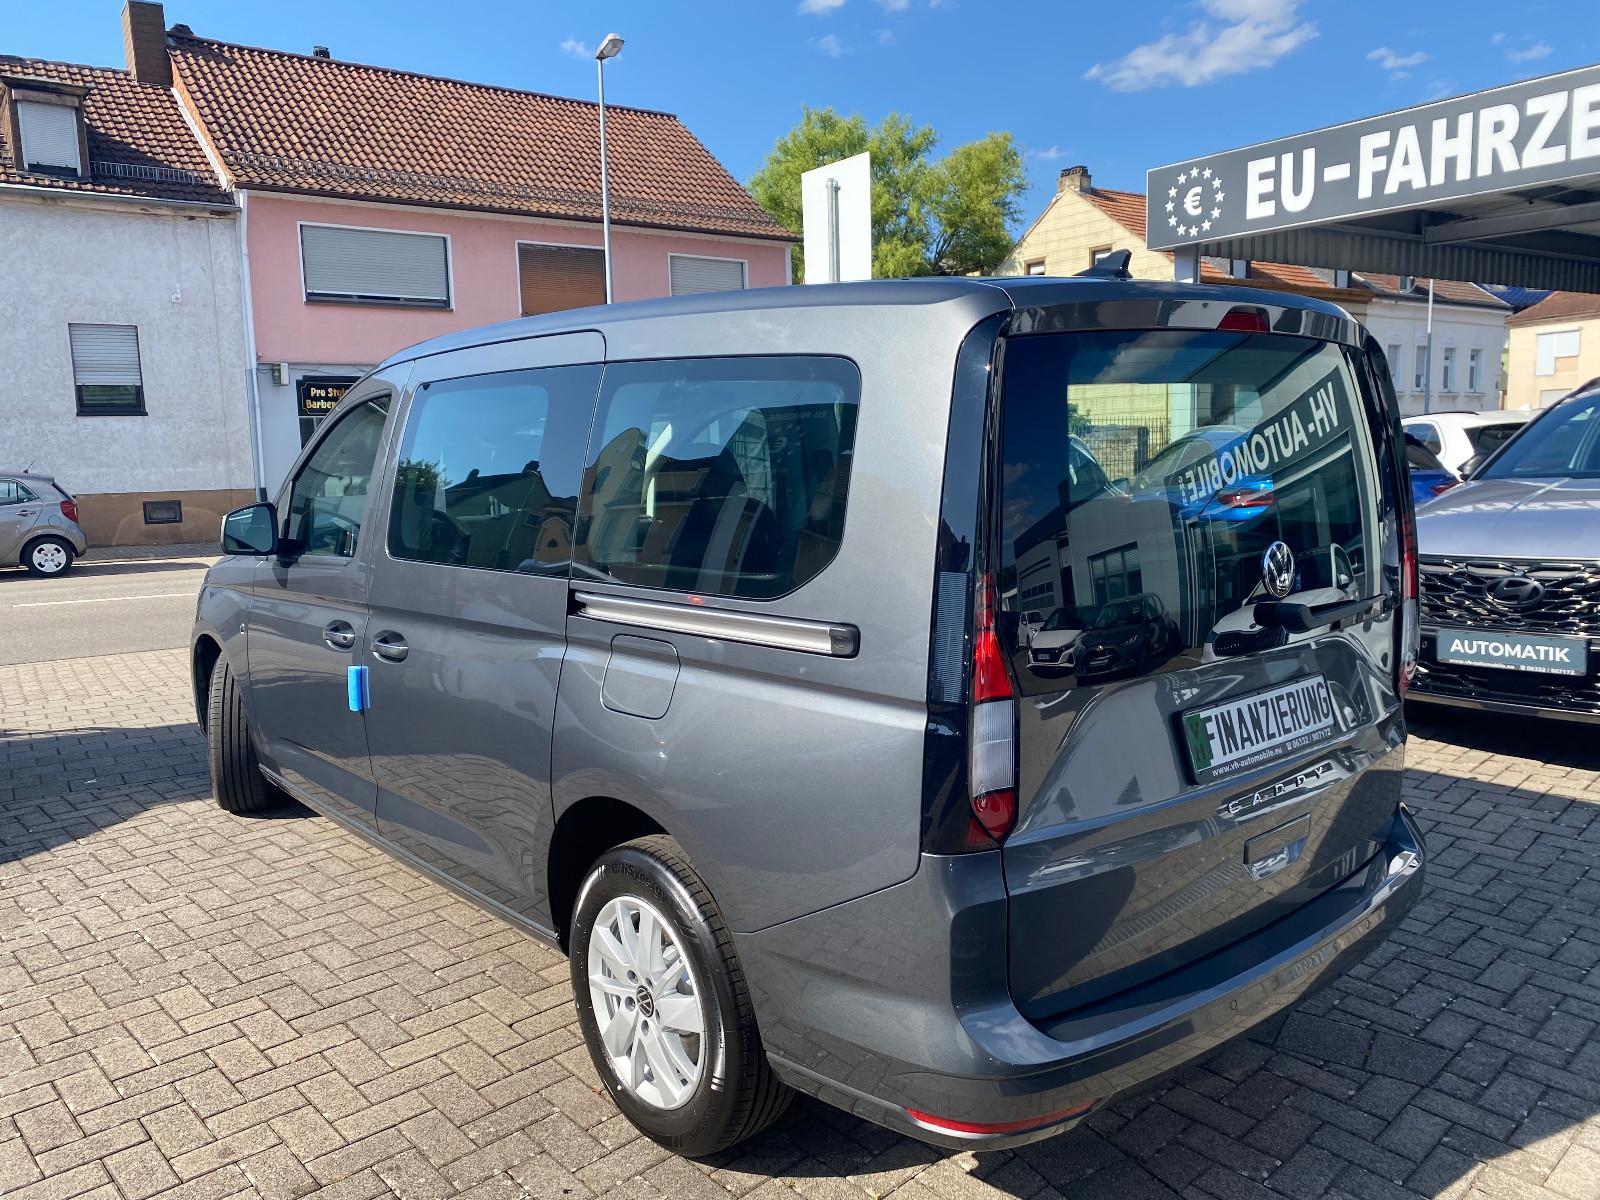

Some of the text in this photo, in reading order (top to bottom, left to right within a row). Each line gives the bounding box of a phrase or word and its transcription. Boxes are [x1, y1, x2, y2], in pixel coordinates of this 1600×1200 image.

[310, 387, 348, 398] Pro Styl
[1450, 638, 1571, 662] AUTOMATIK
[1202, 681, 1331, 761] FINANZIERUNG
[1211, 746, 1283, 777] www.vh-automobile.eu
